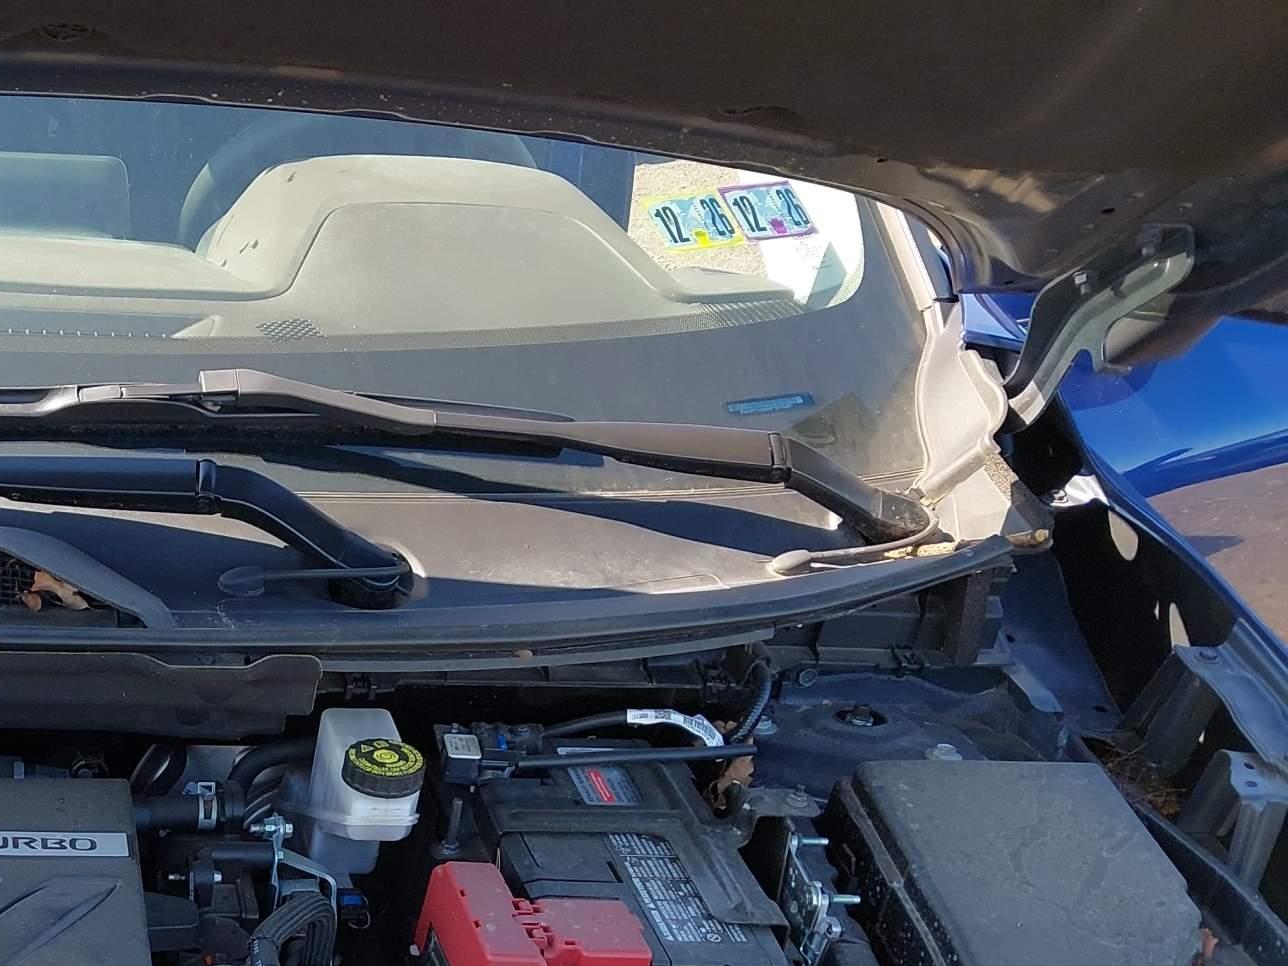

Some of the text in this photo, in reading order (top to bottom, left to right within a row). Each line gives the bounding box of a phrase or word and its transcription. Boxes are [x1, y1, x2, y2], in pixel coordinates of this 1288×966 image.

[654, 206, 691, 244] 12
[700, 197, 736, 236] 26
[732, 195, 767, 232] 12
[775, 188, 809, 226] 26
